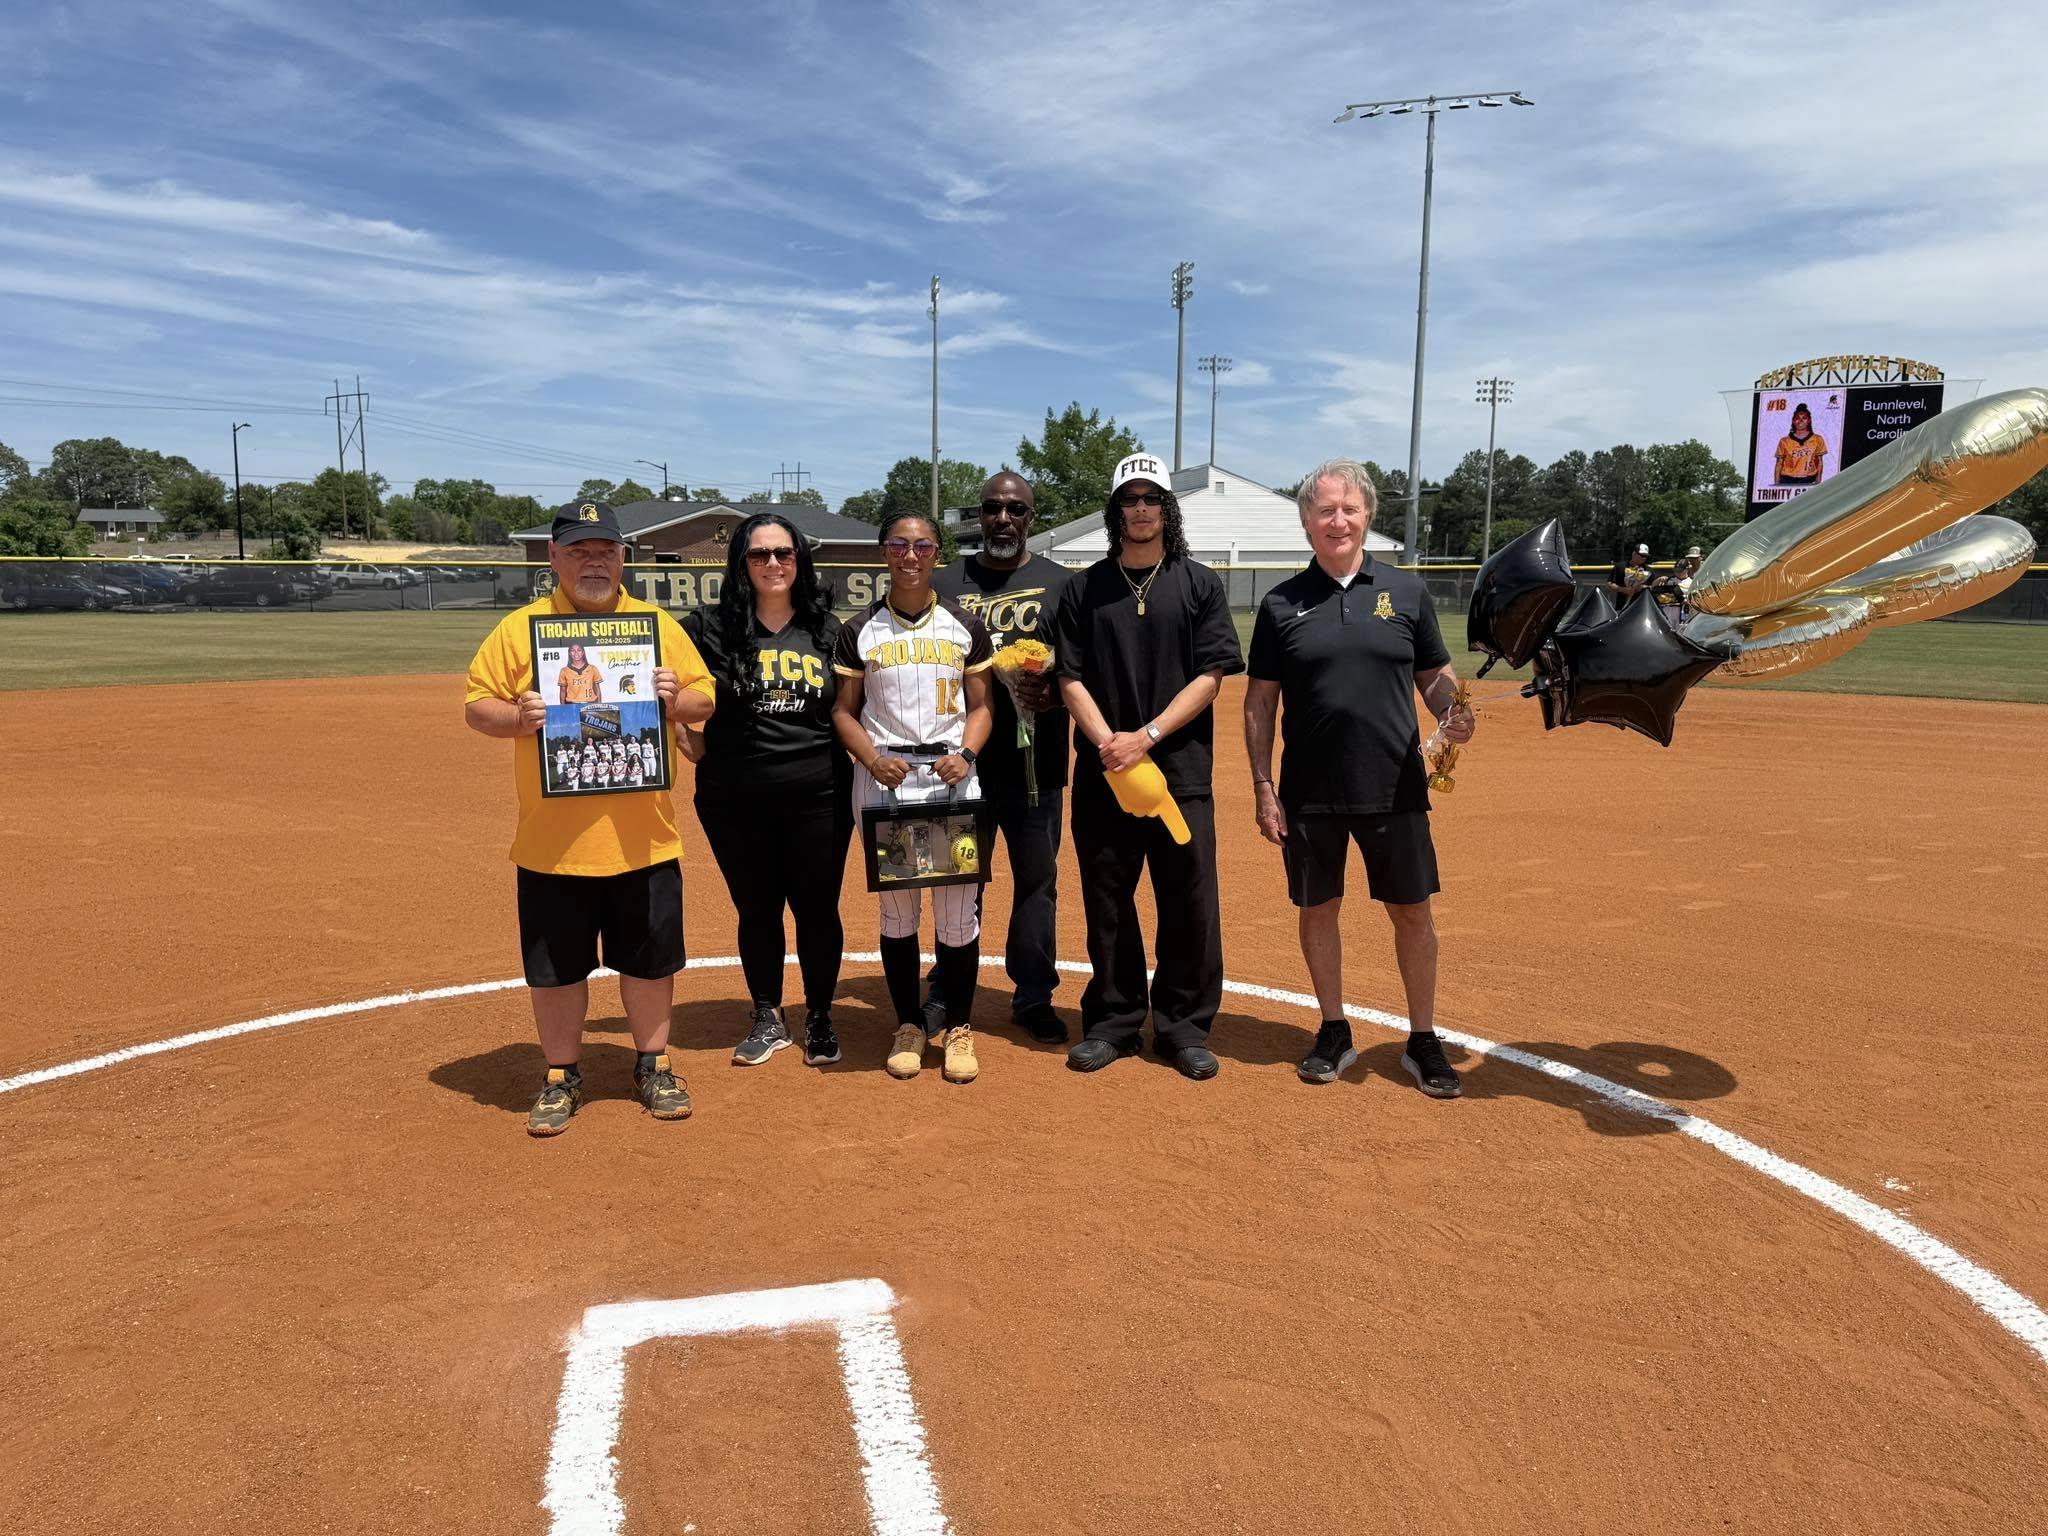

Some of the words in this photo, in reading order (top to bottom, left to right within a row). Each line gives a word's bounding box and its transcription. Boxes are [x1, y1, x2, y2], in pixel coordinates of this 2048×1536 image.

[1760, 355, 1889, 387] FAYETTEVILLE
[1895, 357, 1940, 381] TECH
[1863, 398, 1927, 411] Bunnlevel,
[1876, 414, 1911, 425] North
[1121, 459, 1157, 478] FTCC
[1757, 488, 1792, 500] TRINITY
[538, 622, 588, 639] TROJAN
[591, 620, 651, 637] SOFTBALL
[596, 637, 631, 645] 2024-2025
[542, 651, 561, 662] #18
[597, 650, 650, 664] TRINITY
[866, 637, 965, 673] TROJANS
[769, 689, 790, 700] 1961
[752, 698, 806, 714] Softball
[583, 713, 618, 733] TROJANS
[959, 846, 976, 860] 18
